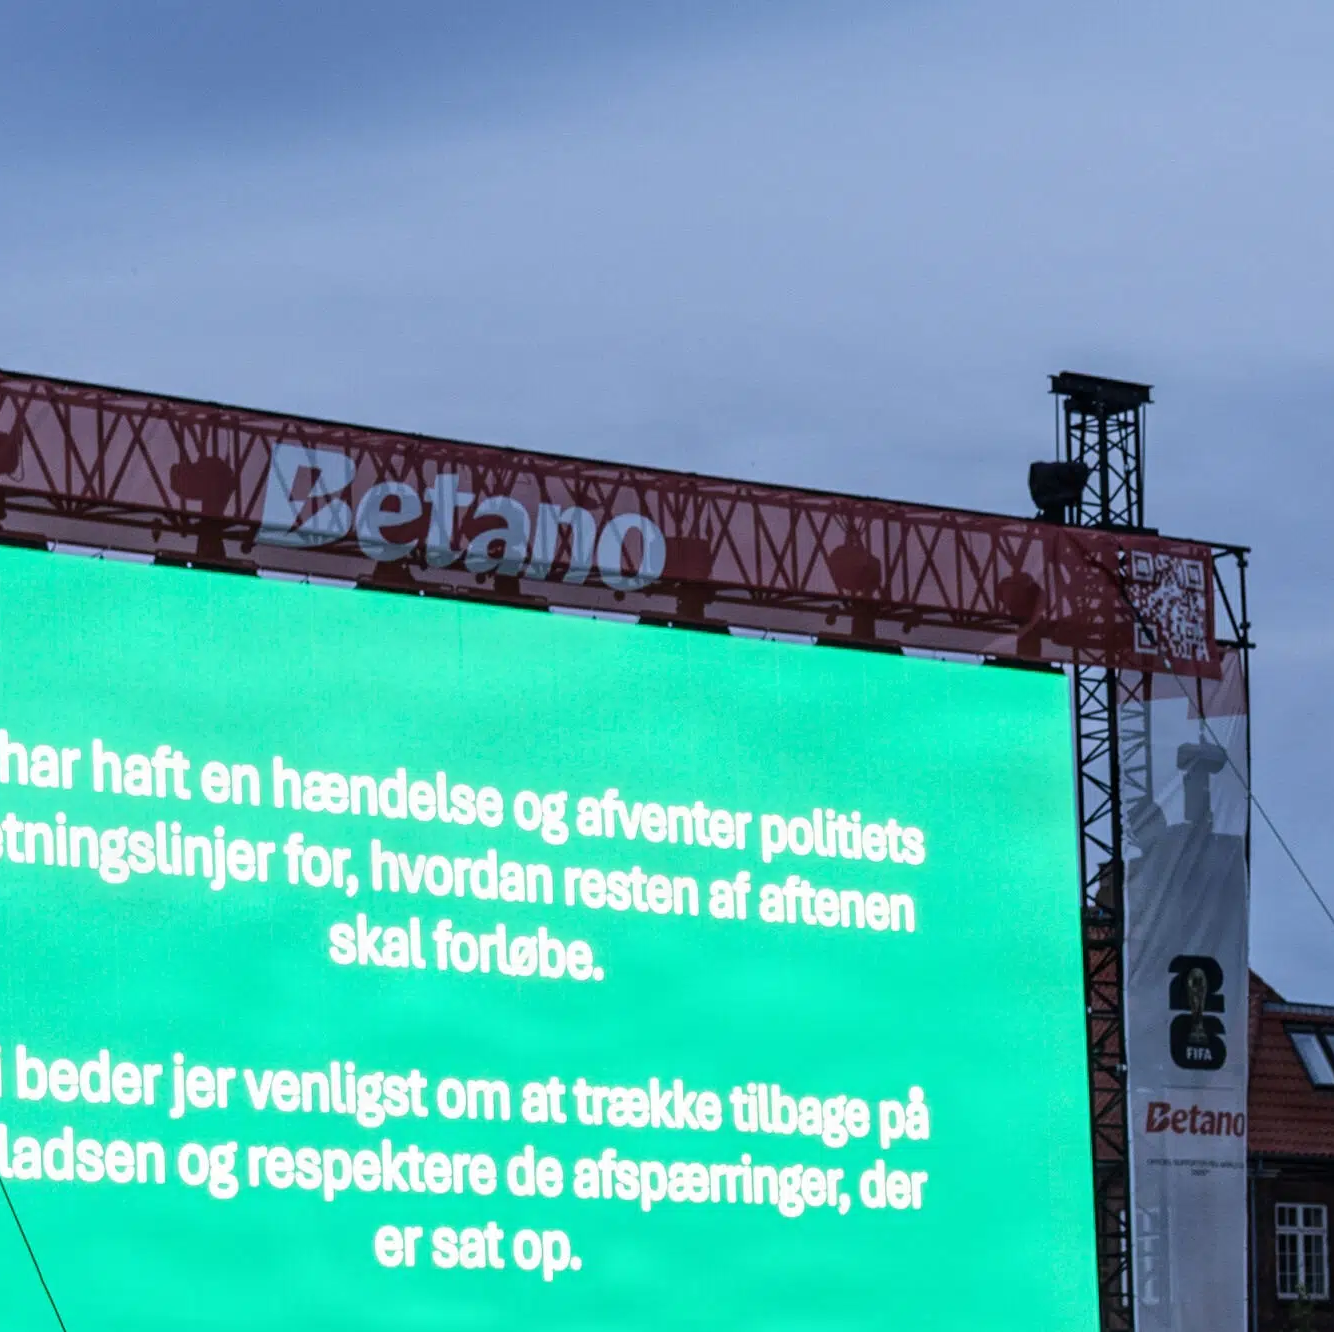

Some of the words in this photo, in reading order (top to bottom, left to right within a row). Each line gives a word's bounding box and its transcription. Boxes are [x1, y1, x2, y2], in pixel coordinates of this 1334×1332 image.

[254, 439, 667, 592] Betano
[92, 738, 191, 800] haft
[200, 761, 260, 806] en
[273, 756, 503, 827] hændelse
[513, 790, 569, 845] og
[576, 788, 752, 849] afventer
[761, 808, 925, 865] politiets
[283, 832, 359, 897] for,
[371, 839, 553, 904] hvordan
[564, 866, 699, 916] resten
[709, 871, 751, 919] af
[759, 875, 915, 932] aftenen
[329, 913, 426, 968] skal
[432, 919, 604, 981] forløbe.
[1186, 1047, 1212, 1061] FIFA
[16, 1045, 163, 1105] beder
[170, 1053, 236, 1118] jer
[243, 1061, 428, 1128] venligst
[437, 1078, 510, 1120] om
[522, 1077, 567, 1123] at
[572, 1078, 722, 1131] trække
[729, 1083, 870, 1148] tilbage
[879, 1086, 929, 1149] på
[1146, 1101, 1245, 1138] Betano
[178, 1141, 239, 1199] og
[248, 1139, 496, 1201] respektere
[507, 1145, 563, 1197] de
[574, 1148, 850, 1217] afspærringer,
[860, 1160, 928, 1209] der
[375, 1225, 423, 1267] er
[432, 1222, 504, 1268] sat
[513, 1229, 581, 1281] op.
